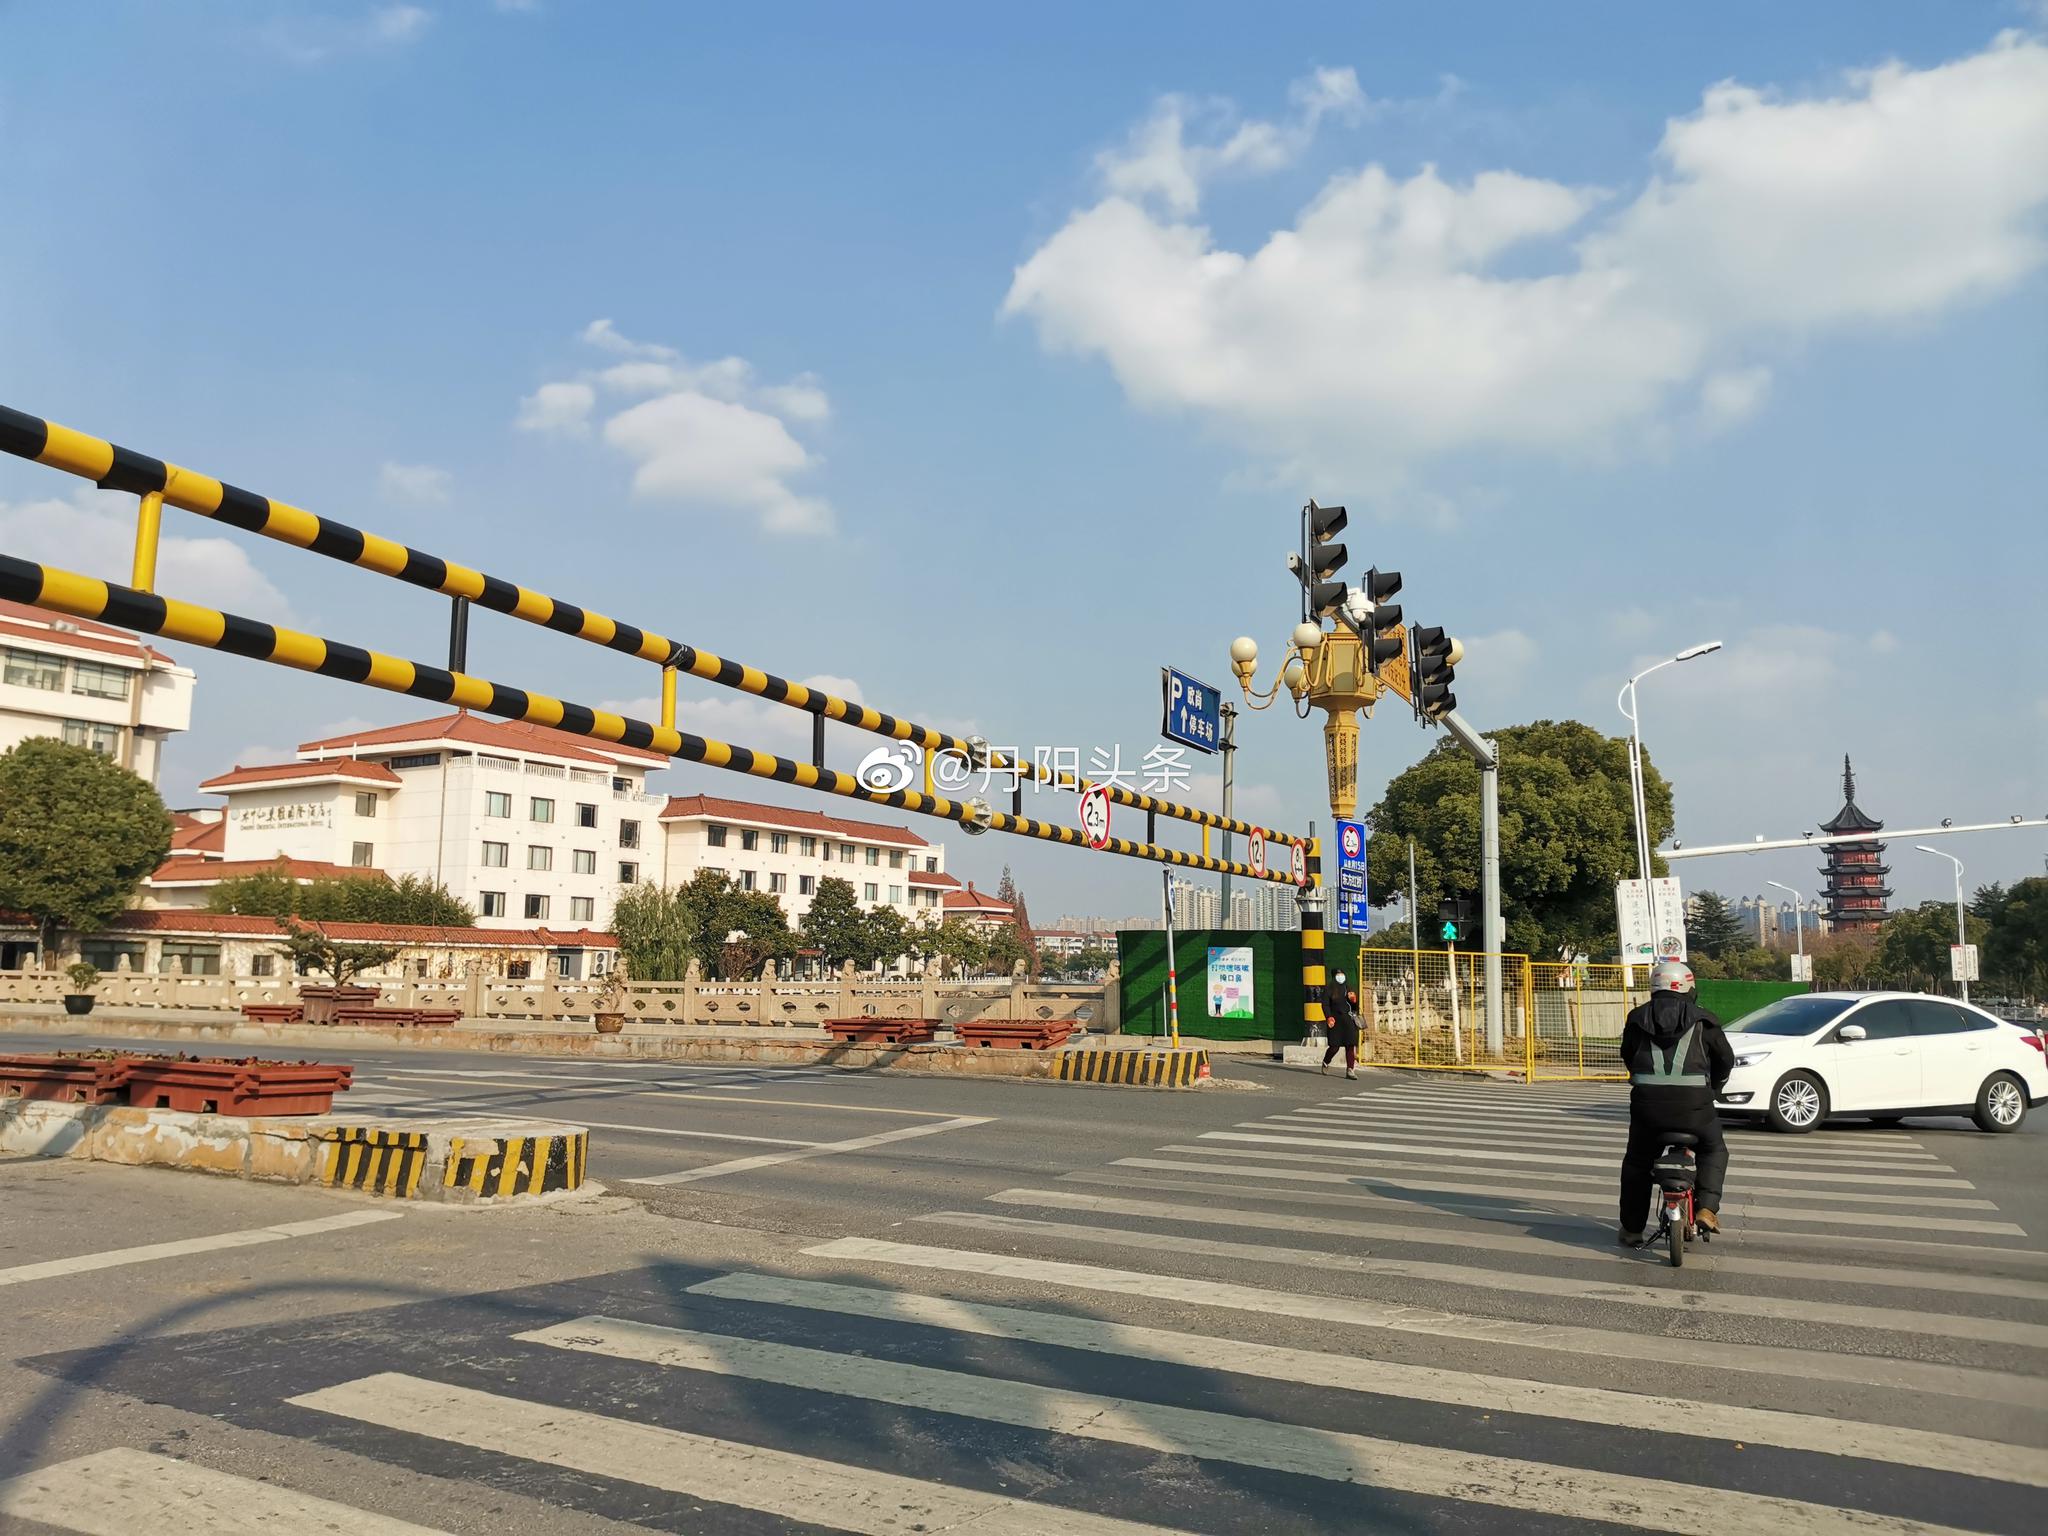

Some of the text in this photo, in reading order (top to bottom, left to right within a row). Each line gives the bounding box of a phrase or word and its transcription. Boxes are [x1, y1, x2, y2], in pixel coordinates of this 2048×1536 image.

[1171, 676, 1183, 711] P
[1190, 714, 1213, 742] 停车场
